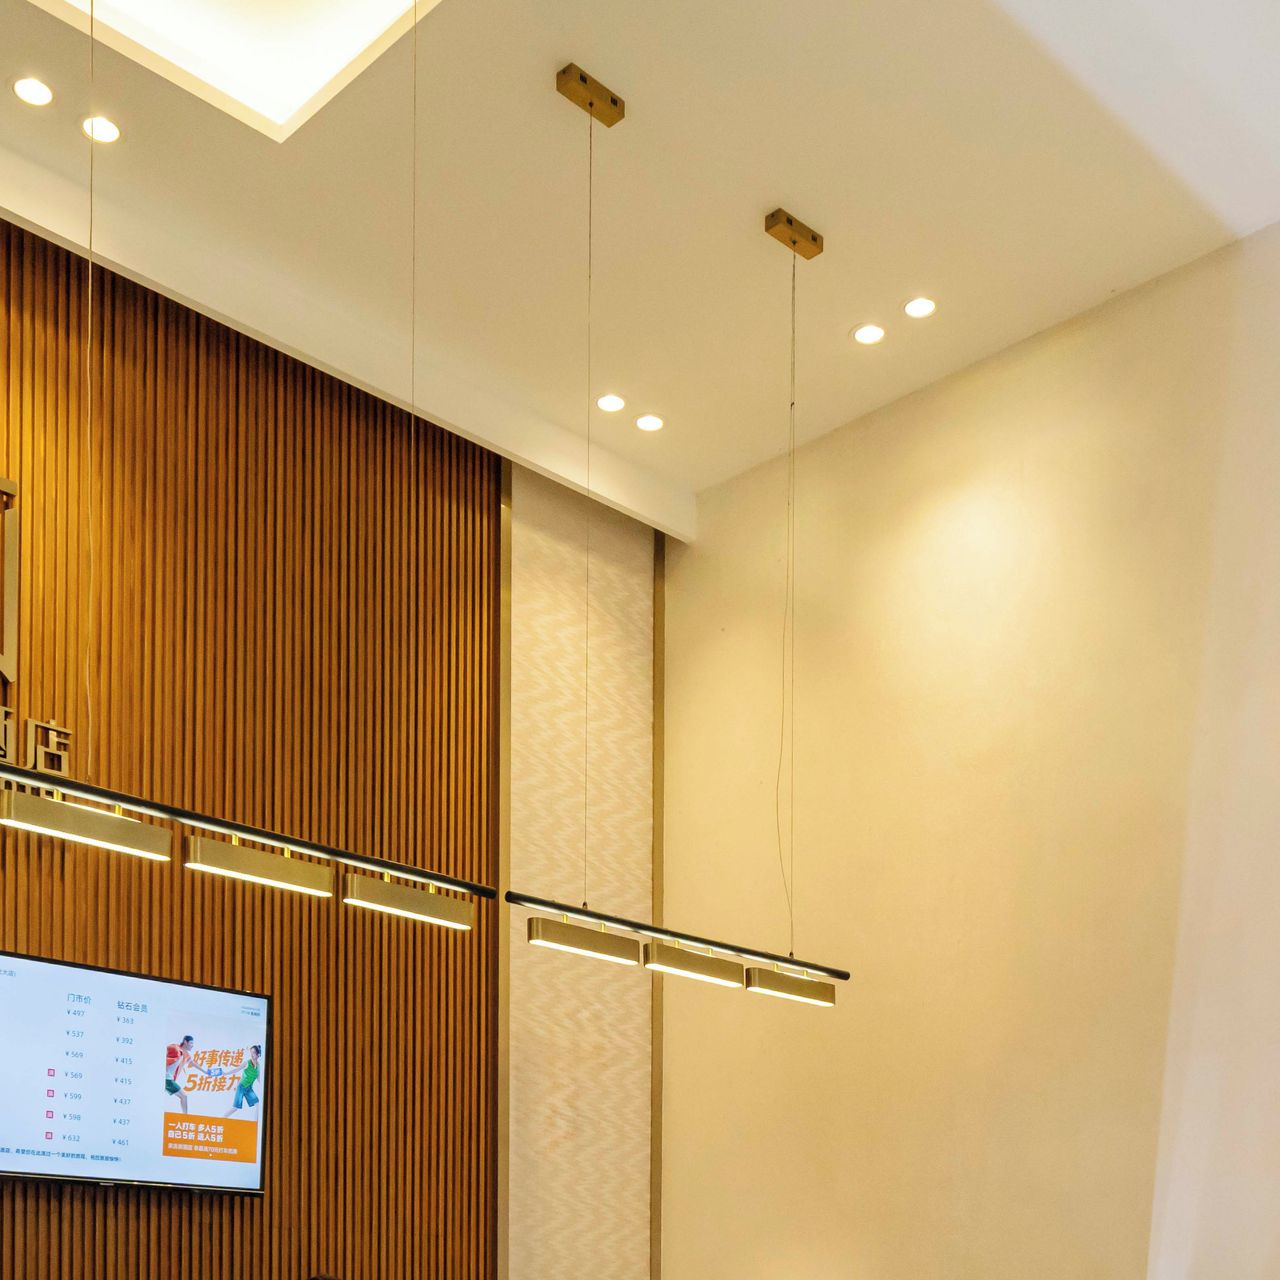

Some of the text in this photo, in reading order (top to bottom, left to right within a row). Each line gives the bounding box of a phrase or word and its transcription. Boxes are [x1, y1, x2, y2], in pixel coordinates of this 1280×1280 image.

[67, 993, 92, 1005] 门市价
[117, 1001, 148, 1013] 钻石会员
[192, 1047, 245, 1068] 好事传递
[183, 1073, 242, 1092] 5折接力
[168, 1121, 224, 1134] 一人打车 多人5折
